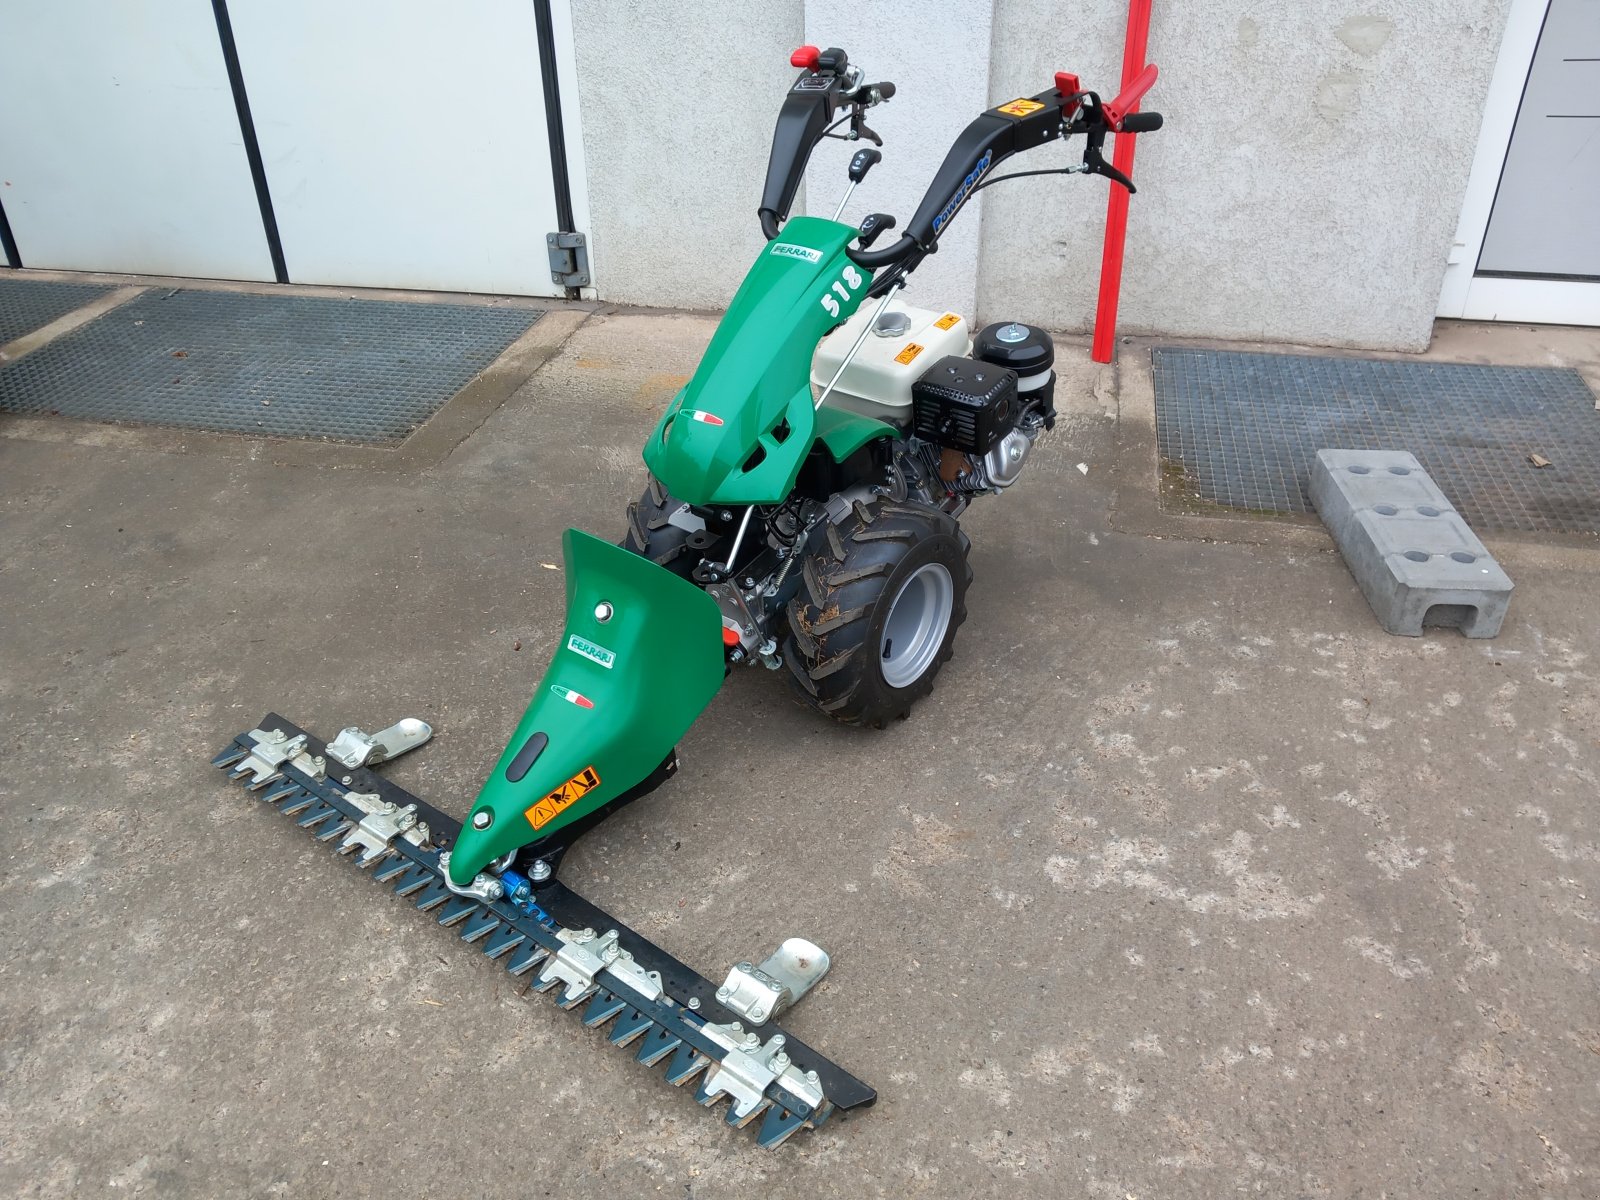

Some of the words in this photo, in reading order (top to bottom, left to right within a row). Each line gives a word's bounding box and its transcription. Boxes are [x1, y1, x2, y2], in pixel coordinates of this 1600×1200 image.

[933, 156, 989, 233] PowerSafe
[773, 245, 818, 261] FERRARI
[820, 265, 863, 318] 518
[571, 638, 612, 664] FERRARI
